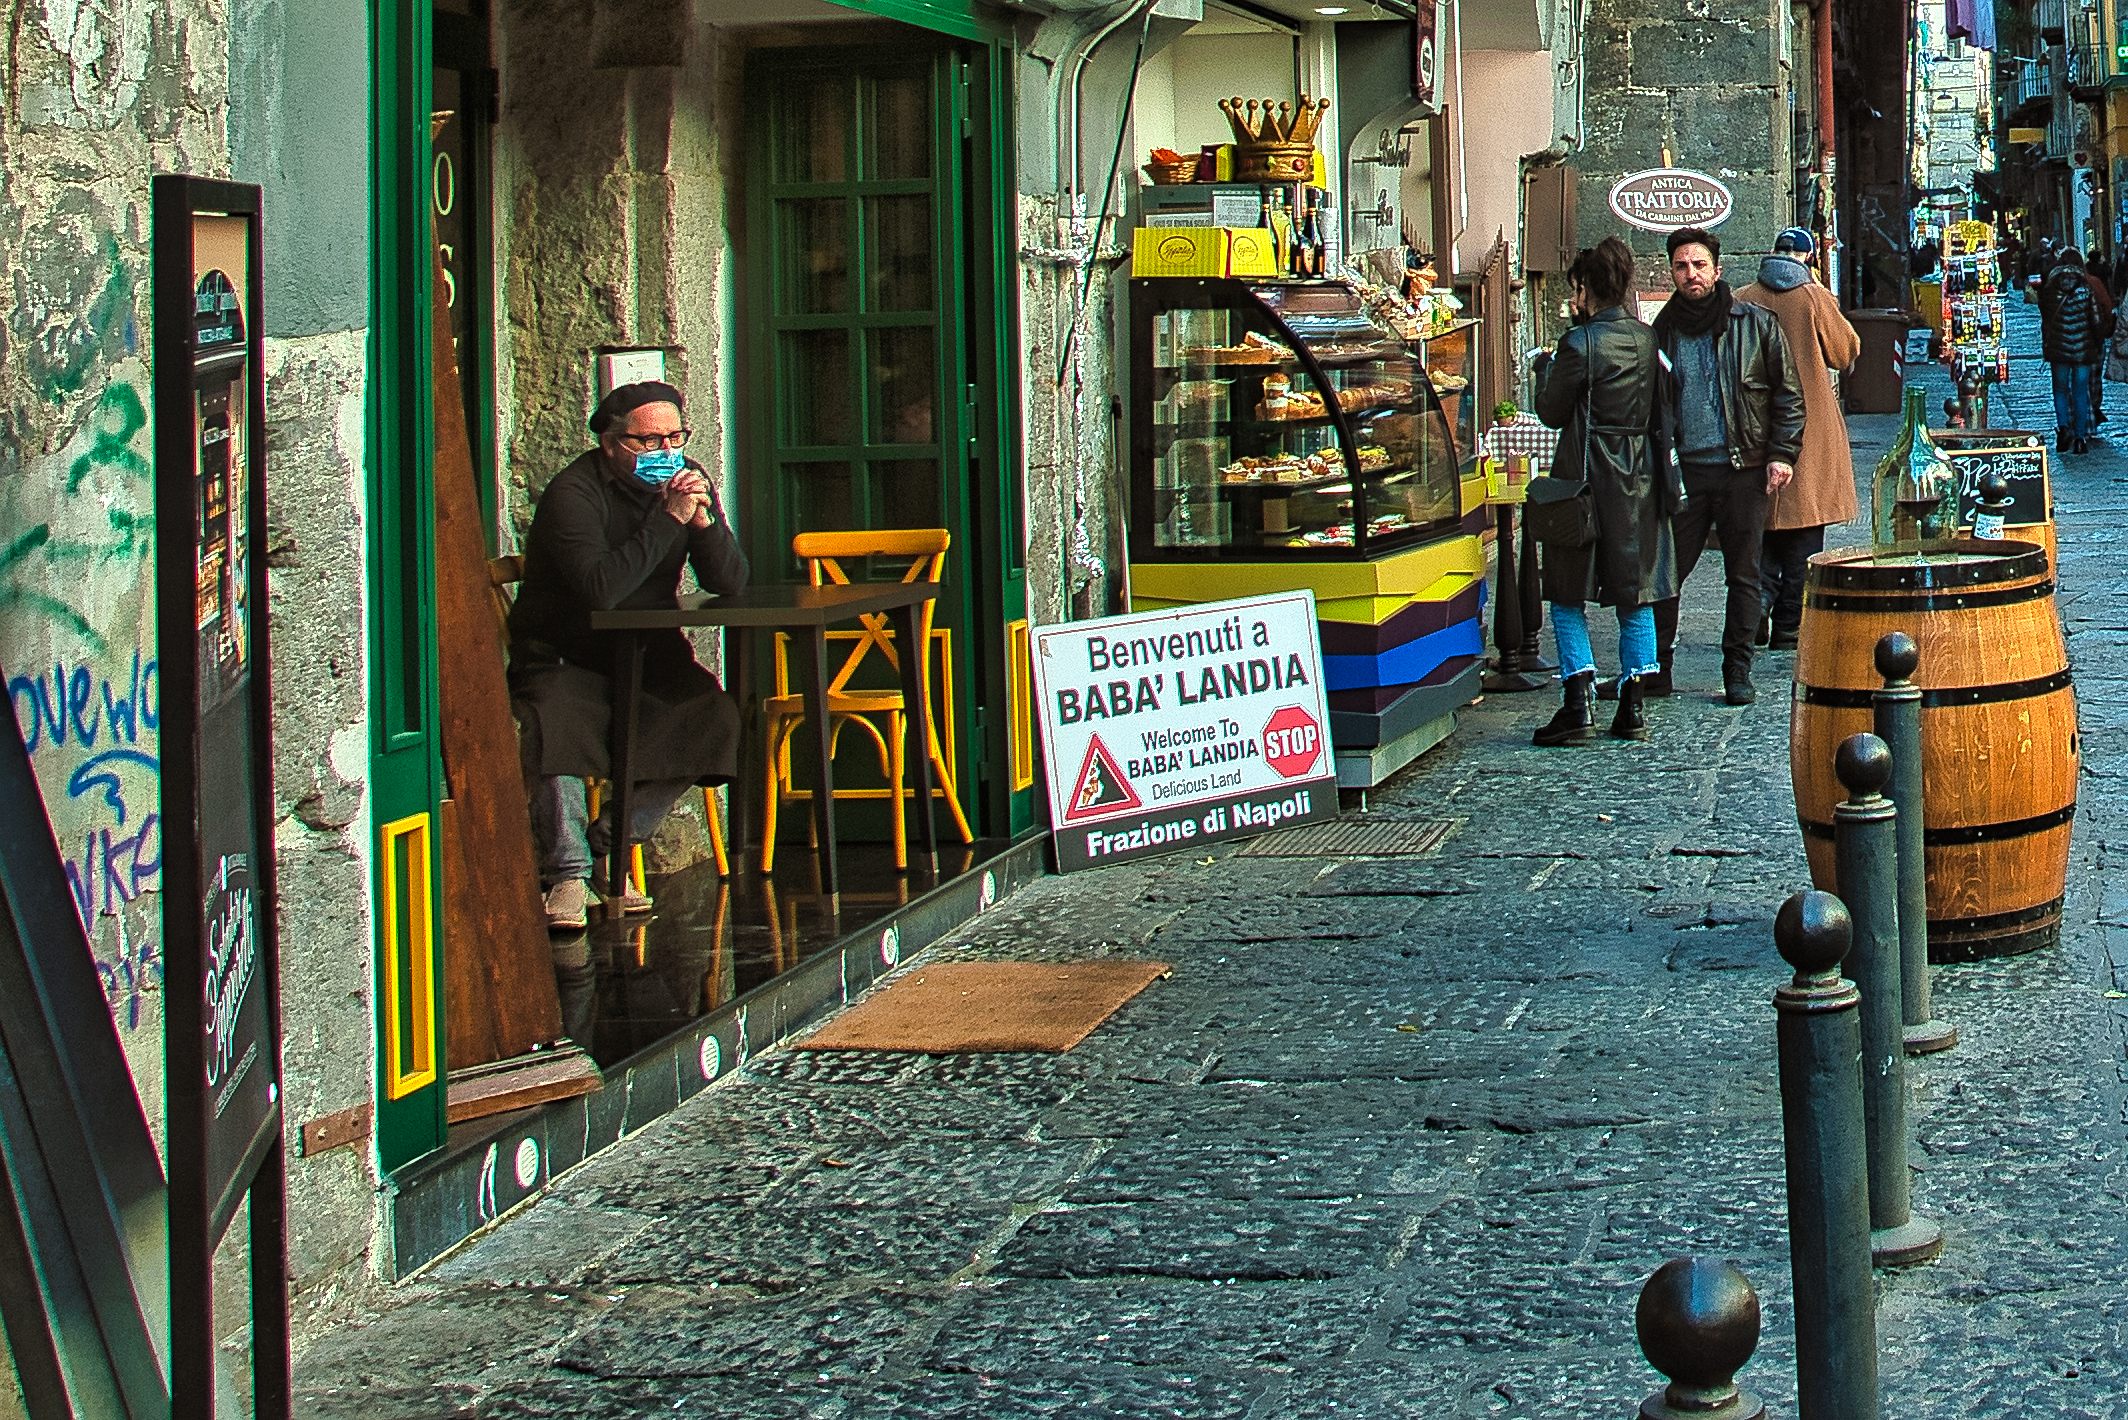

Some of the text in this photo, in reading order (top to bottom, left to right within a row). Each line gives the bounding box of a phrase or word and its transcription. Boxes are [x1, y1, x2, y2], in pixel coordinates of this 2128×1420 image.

[1620, 191, 1726, 209] TRATTORIA
[1651, 178, 1693, 190] ANTICA
[1087, 616, 1270, 673] Benvenuti a
[1057, 652, 1310, 726] BABA' LANDIA
[1141, 718, 1240, 752] Welcome To
[1265, 724, 1318, 760] STOP
[1127, 739, 1261, 780] BABA' LANDIA
[1151, 769, 1242, 801] Delicious Land
[1086, 790, 1312, 858] Frazione di Napoli
